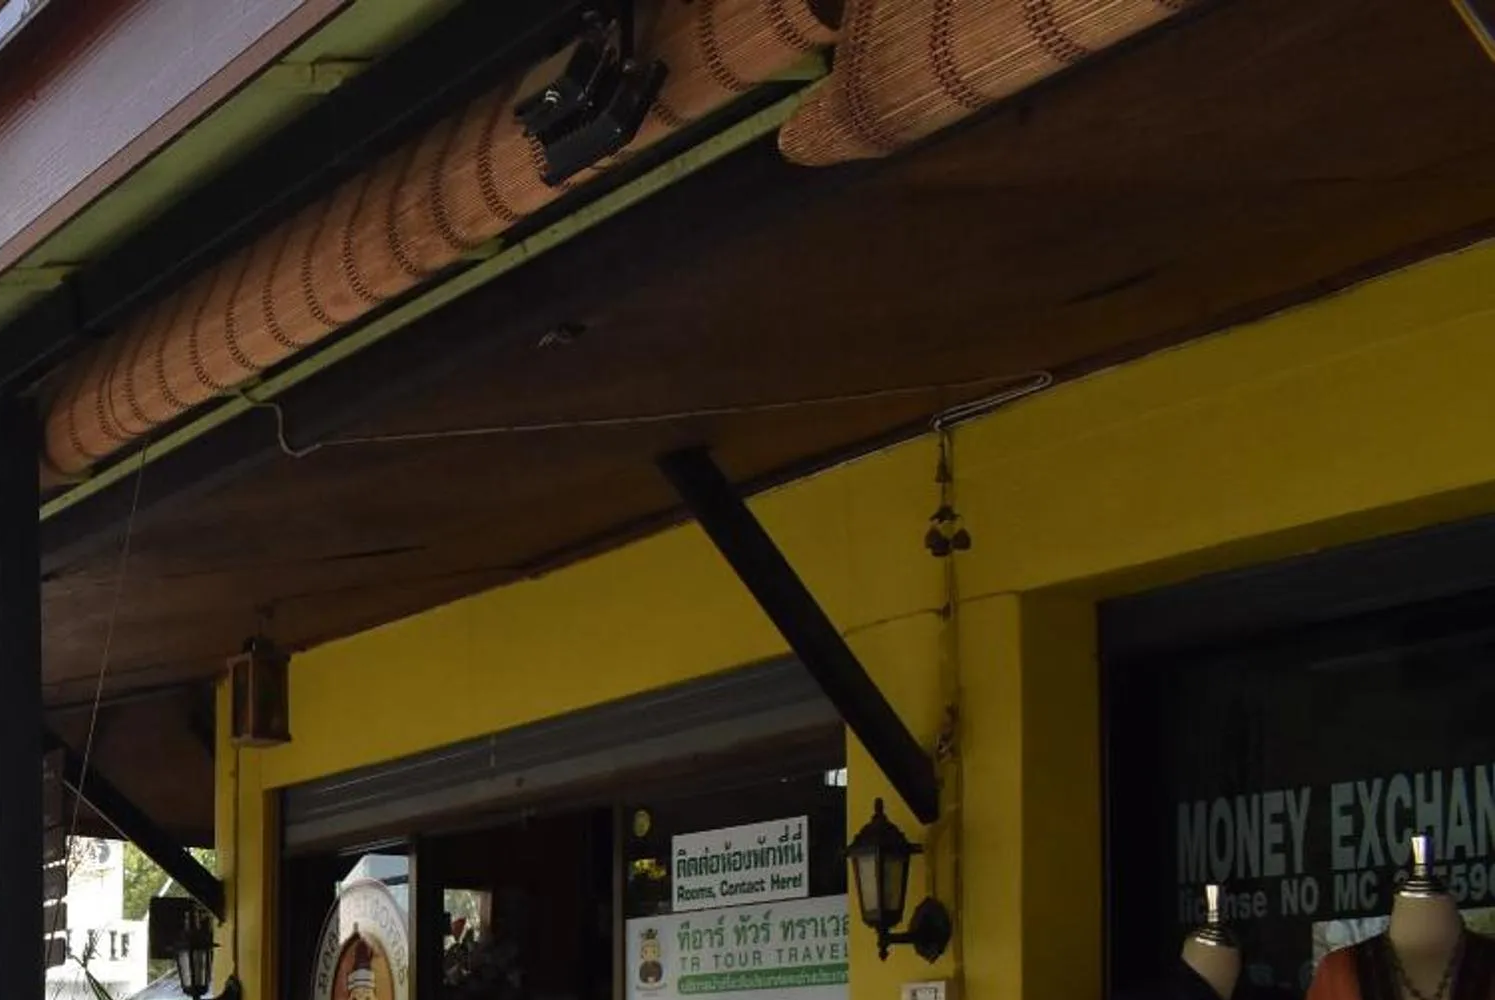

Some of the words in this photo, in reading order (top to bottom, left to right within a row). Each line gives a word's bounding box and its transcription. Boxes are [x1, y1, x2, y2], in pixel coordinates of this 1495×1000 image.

[676, 823, 803, 878] ติดต่อห้องพักที่นี่
[1177, 786, 1311, 885] MONEY
[720, 878, 766, 896] Contact
[1178, 884, 1268, 923] licnse
[1281, 878, 1320, 917] NO
[1335, 870, 1378, 911] MC
[677, 914, 726, 951] ทีอาร์
[733, 909, 772, 946] ทัวร์
[679, 955, 701, 972] TR
[712, 951, 764, 968] TOUR
